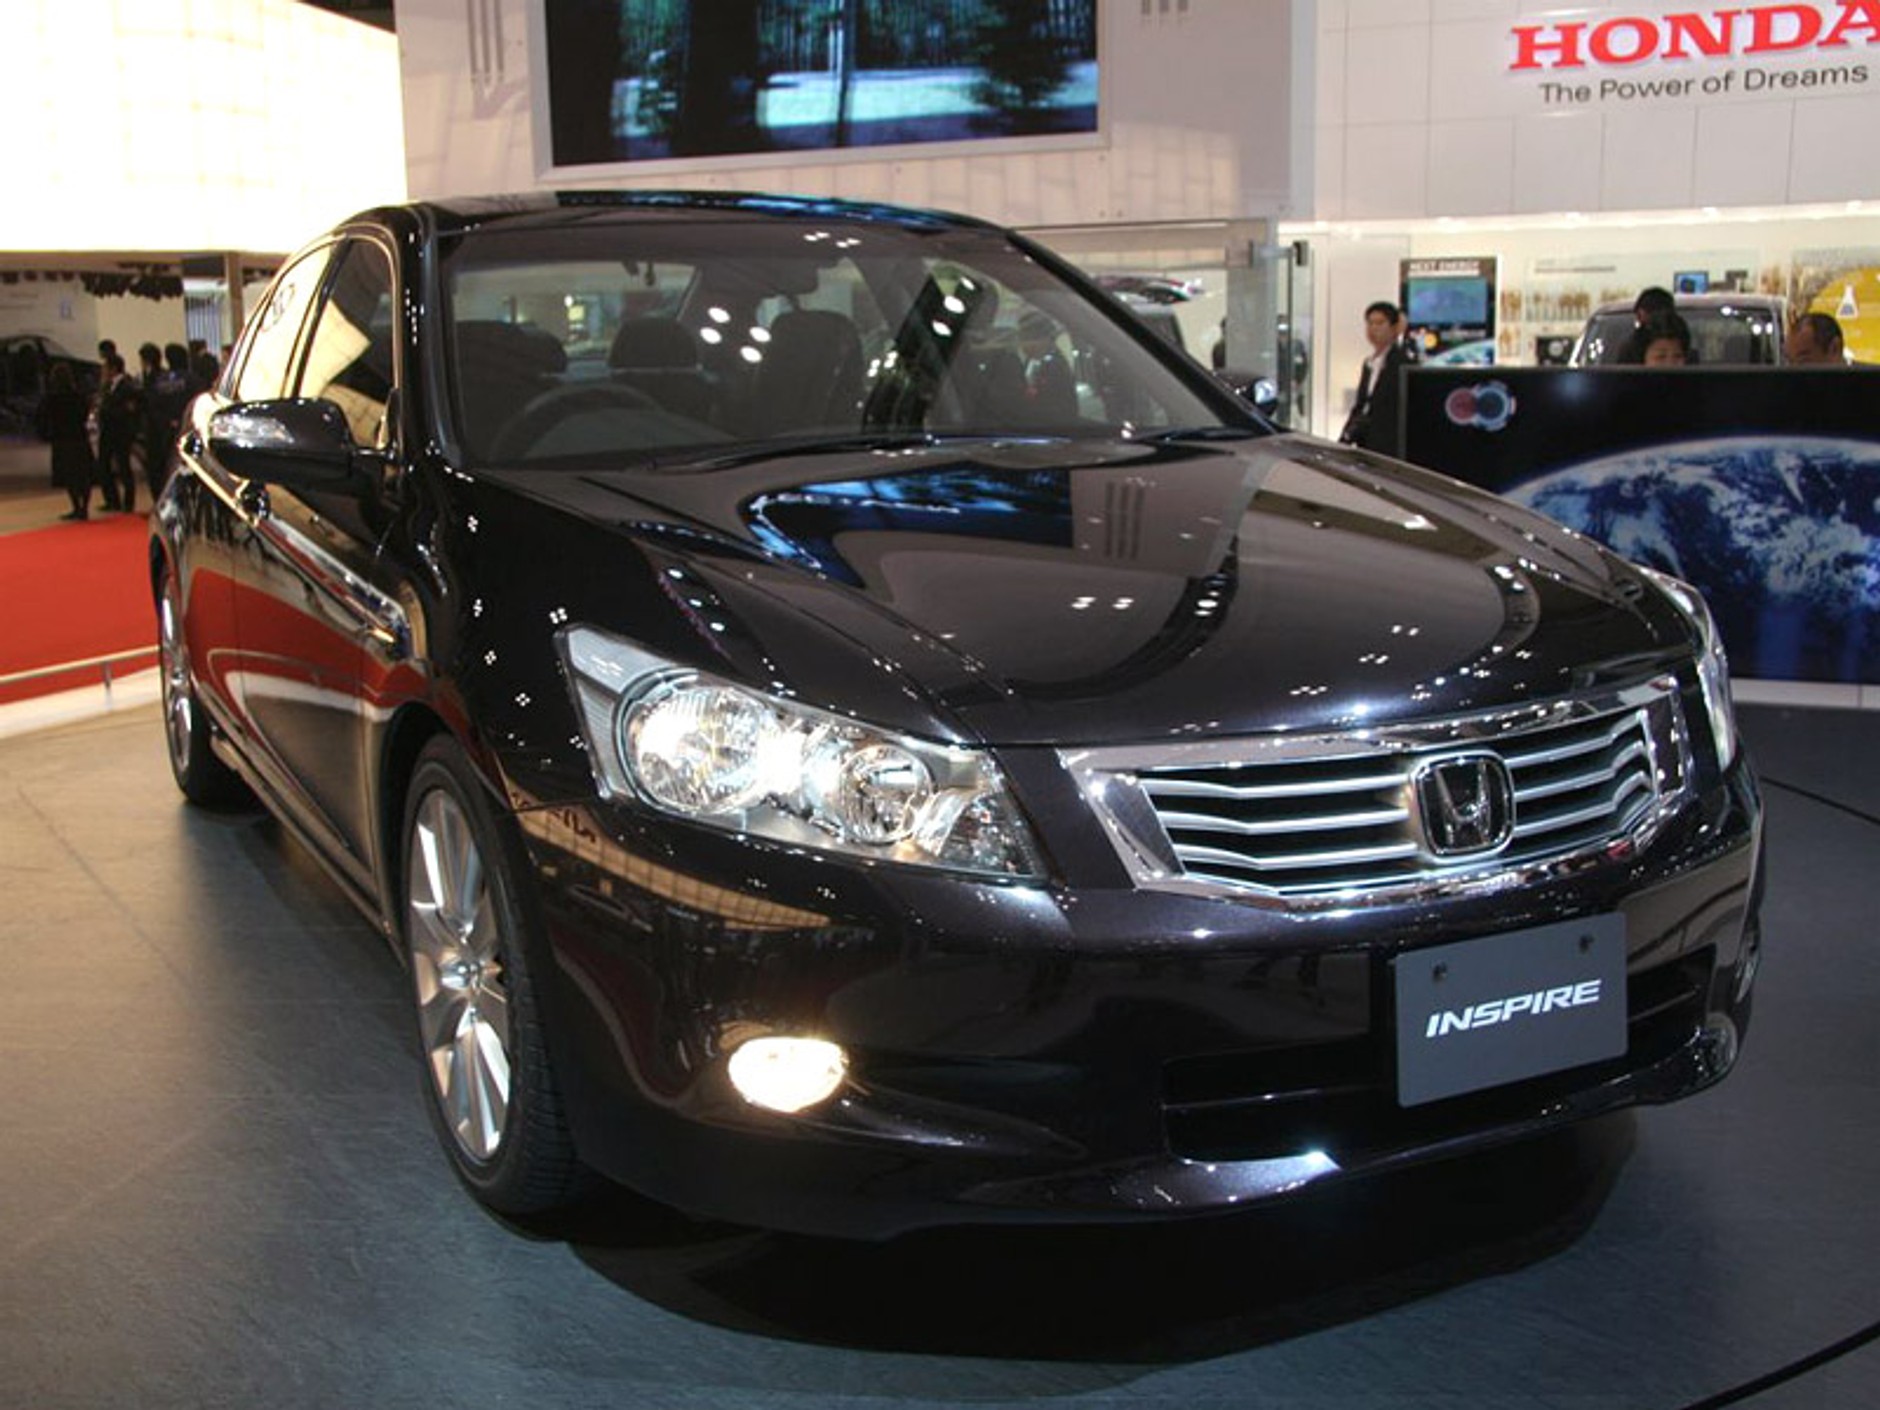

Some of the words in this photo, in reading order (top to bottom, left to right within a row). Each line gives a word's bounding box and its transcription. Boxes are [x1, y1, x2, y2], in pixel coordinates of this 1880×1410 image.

[1509, 0, 1880, 70] HONDA
[1539, 82, 1591, 103] The
[1600, 77, 1695, 99] Power
[1702, 69, 1735, 93] of
[1744, 65, 1868, 91] Dreams
[1425, 978, 1602, 1038] INSPIRE
